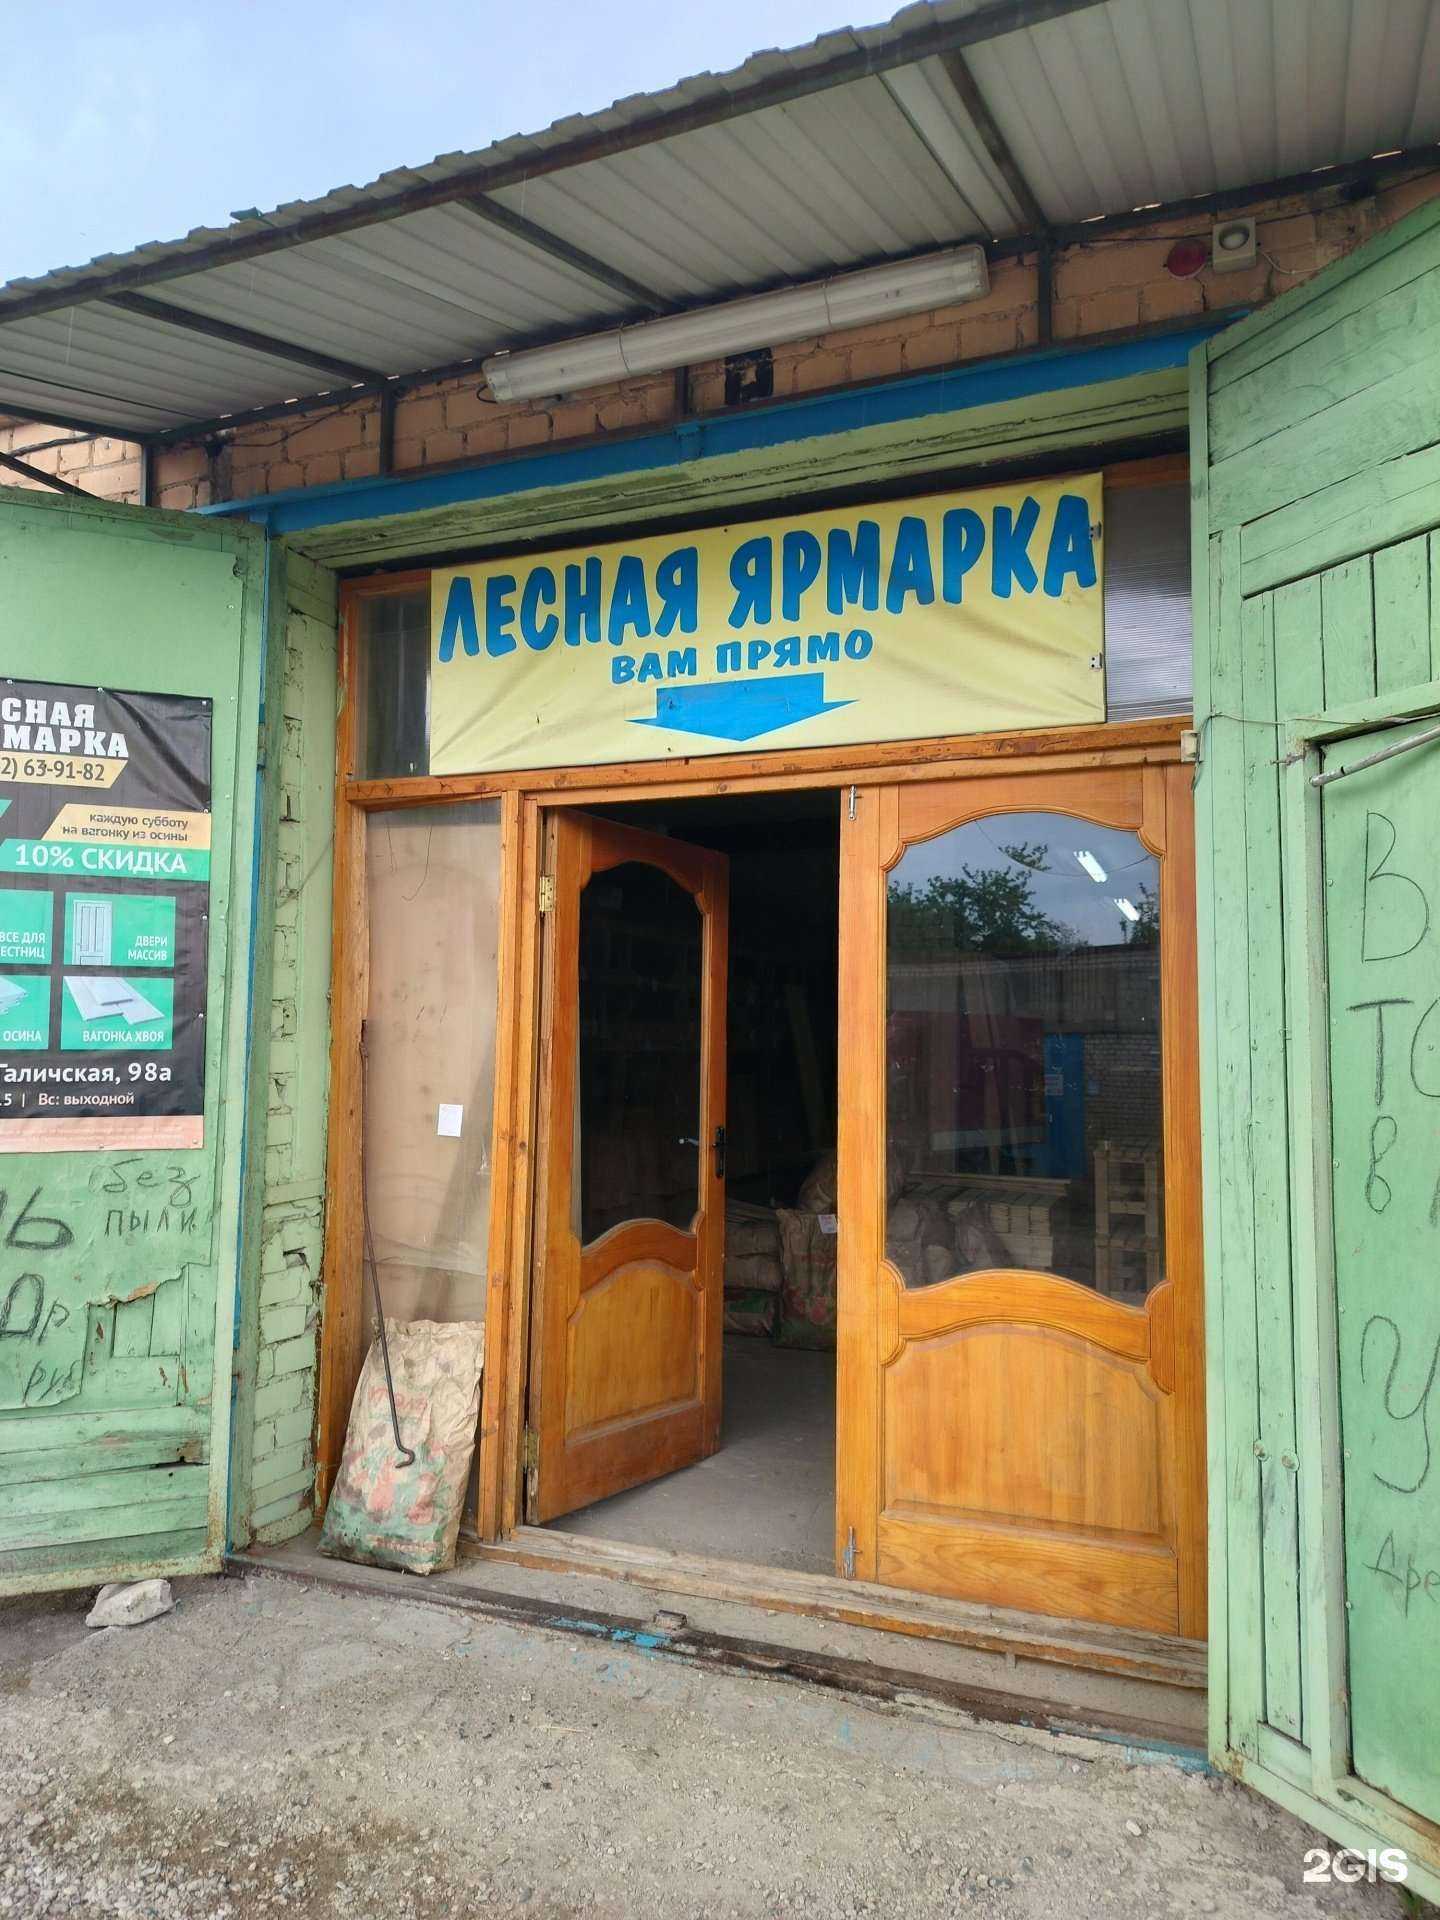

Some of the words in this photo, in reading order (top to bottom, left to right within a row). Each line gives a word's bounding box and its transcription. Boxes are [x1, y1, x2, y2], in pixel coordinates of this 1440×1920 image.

[438, 545, 700, 662] ЛЕСНАЯ
[728, 494, 1098, 631] ЯРМАРКА
[611, 646, 698, 685] ВАМ
[717, 628, 874, 674] ПРЯМО
[23, 758, 106, 782] 63-91-82
[89, 812, 138, 826] каждую
[142, 815, 189, 831] субботу
[62, 825, 78, 835] на
[81, 827, 130, 840] вагонку
[132, 829, 146, 839] из
[150, 830, 189, 842] осины
[15, 843, 75, 868] 10%
[81, 847, 188, 875] СКИДКА
[21, 931, 46, 945] ДЛЯ
[135, 935, 168, 948] ДВЕРИ
[127, 949, 168, 962] МАССИВ
[3, 1030, 42, 1043] ОСИНА
[82, 1030, 133, 1043] ВАГОНКА
[134, 1030, 165, 1043] ХВОЯ
[127, 1061, 172, 1083] 98а
[0, 1092, 13, 1107] 5
[38, 1092, 60, 1106] Вс:
[63, 1091, 135, 1107] выходной
